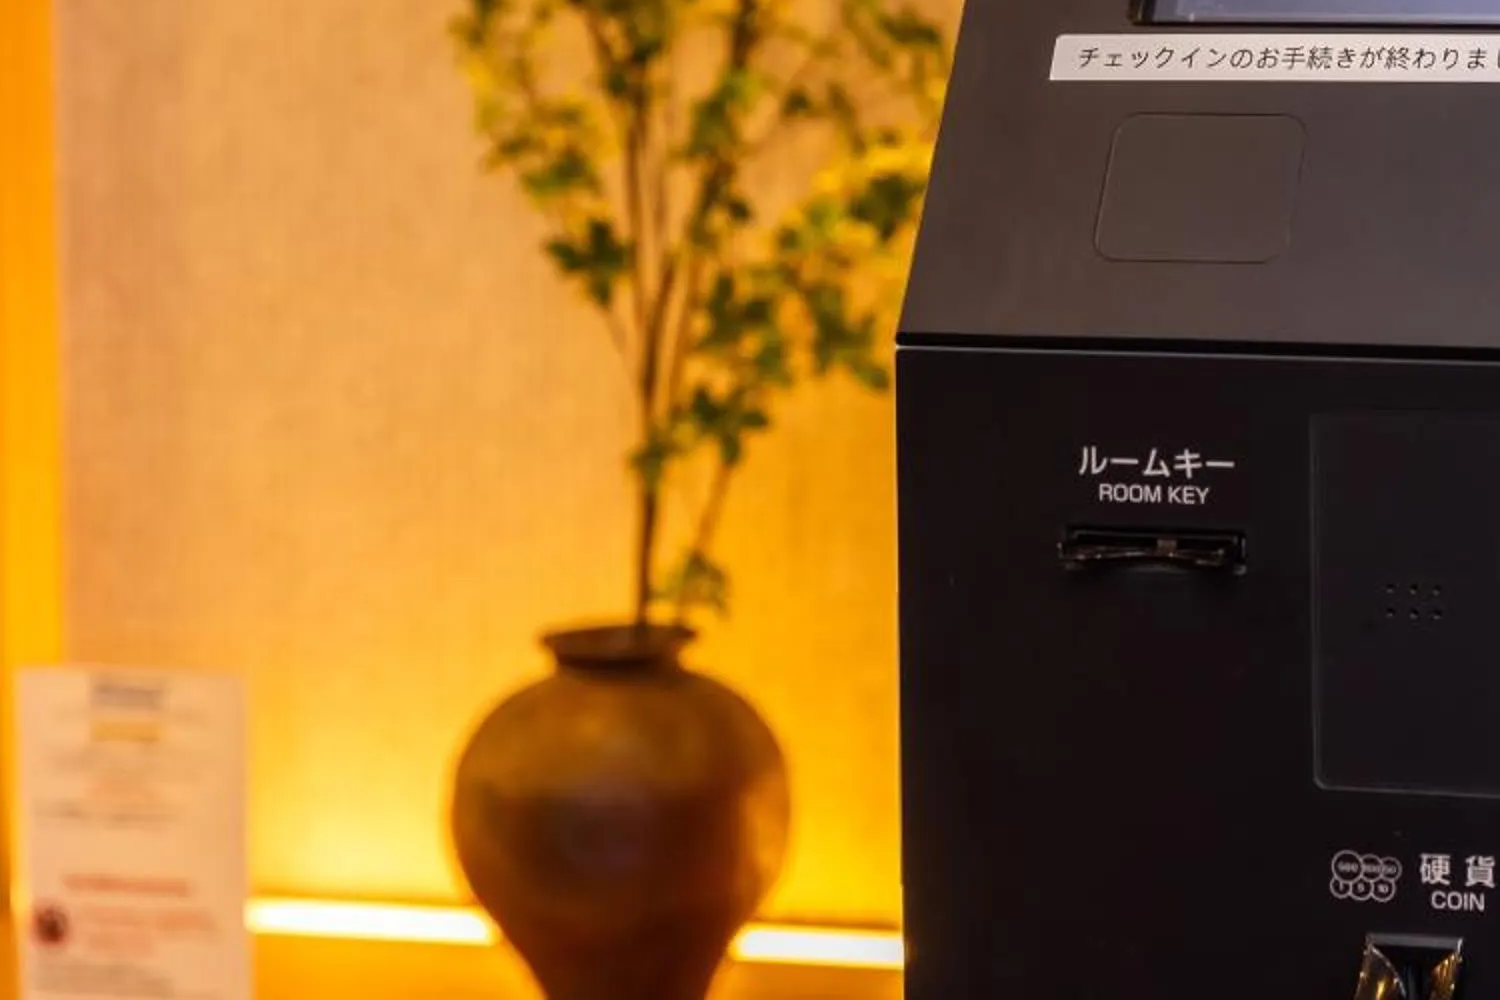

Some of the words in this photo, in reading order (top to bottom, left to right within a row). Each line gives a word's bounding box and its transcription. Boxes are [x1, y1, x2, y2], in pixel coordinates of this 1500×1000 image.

[1079, 446, 1235, 479] ルームキー
[1099, 483, 1161, 503] ROOM
[1167, 486, 1209, 505] KEY
[1420, 853, 1495, 888] 硬貨
[1431, 891, 1485, 912] COIN
